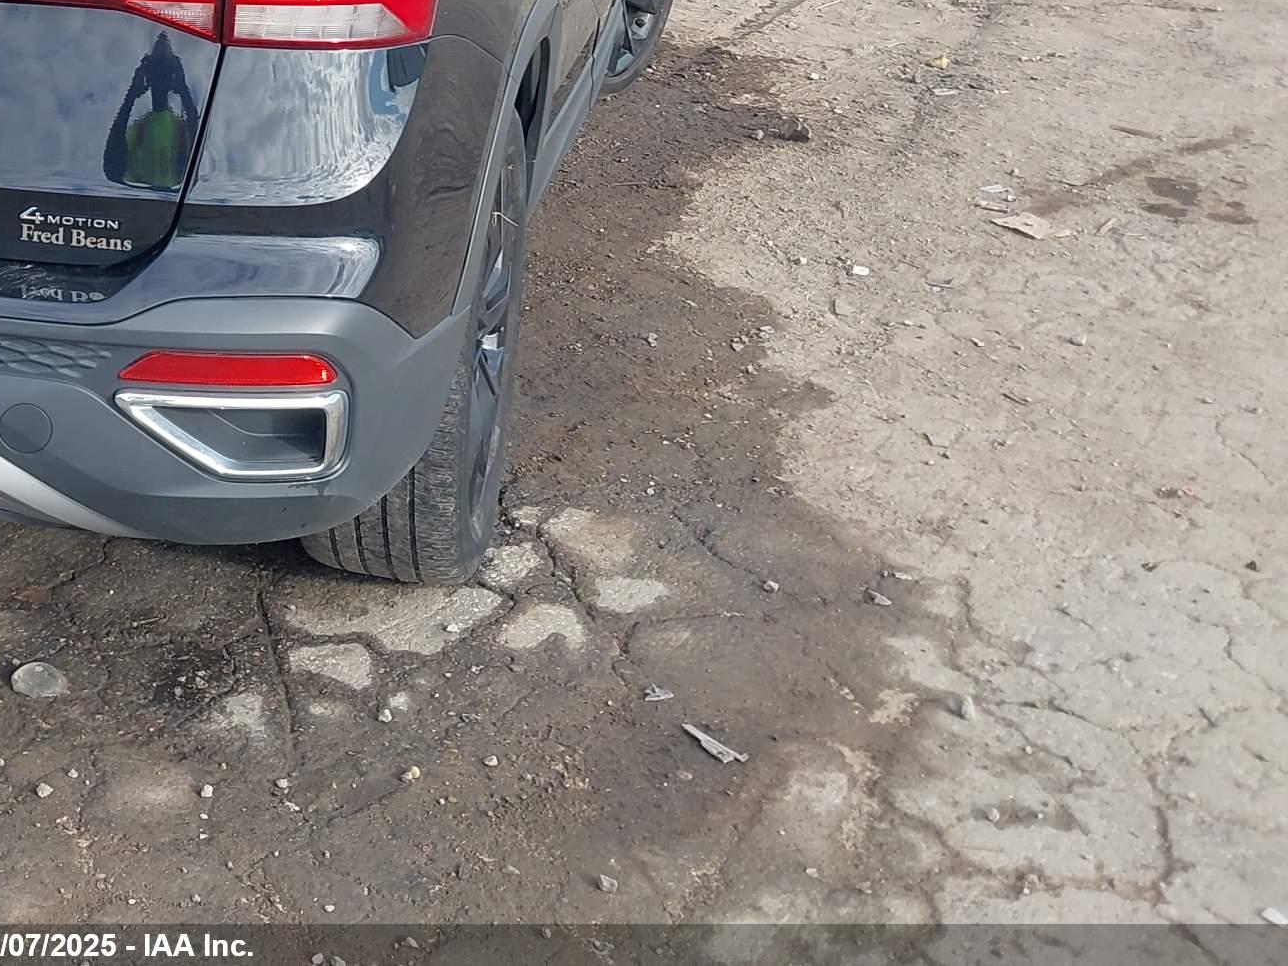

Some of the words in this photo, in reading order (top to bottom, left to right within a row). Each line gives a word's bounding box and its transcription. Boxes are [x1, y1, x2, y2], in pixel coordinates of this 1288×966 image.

[19, 206, 120, 230] 4MOTION
[19, 223, 65, 245] Fred
[70, 228, 133, 251] Beans
